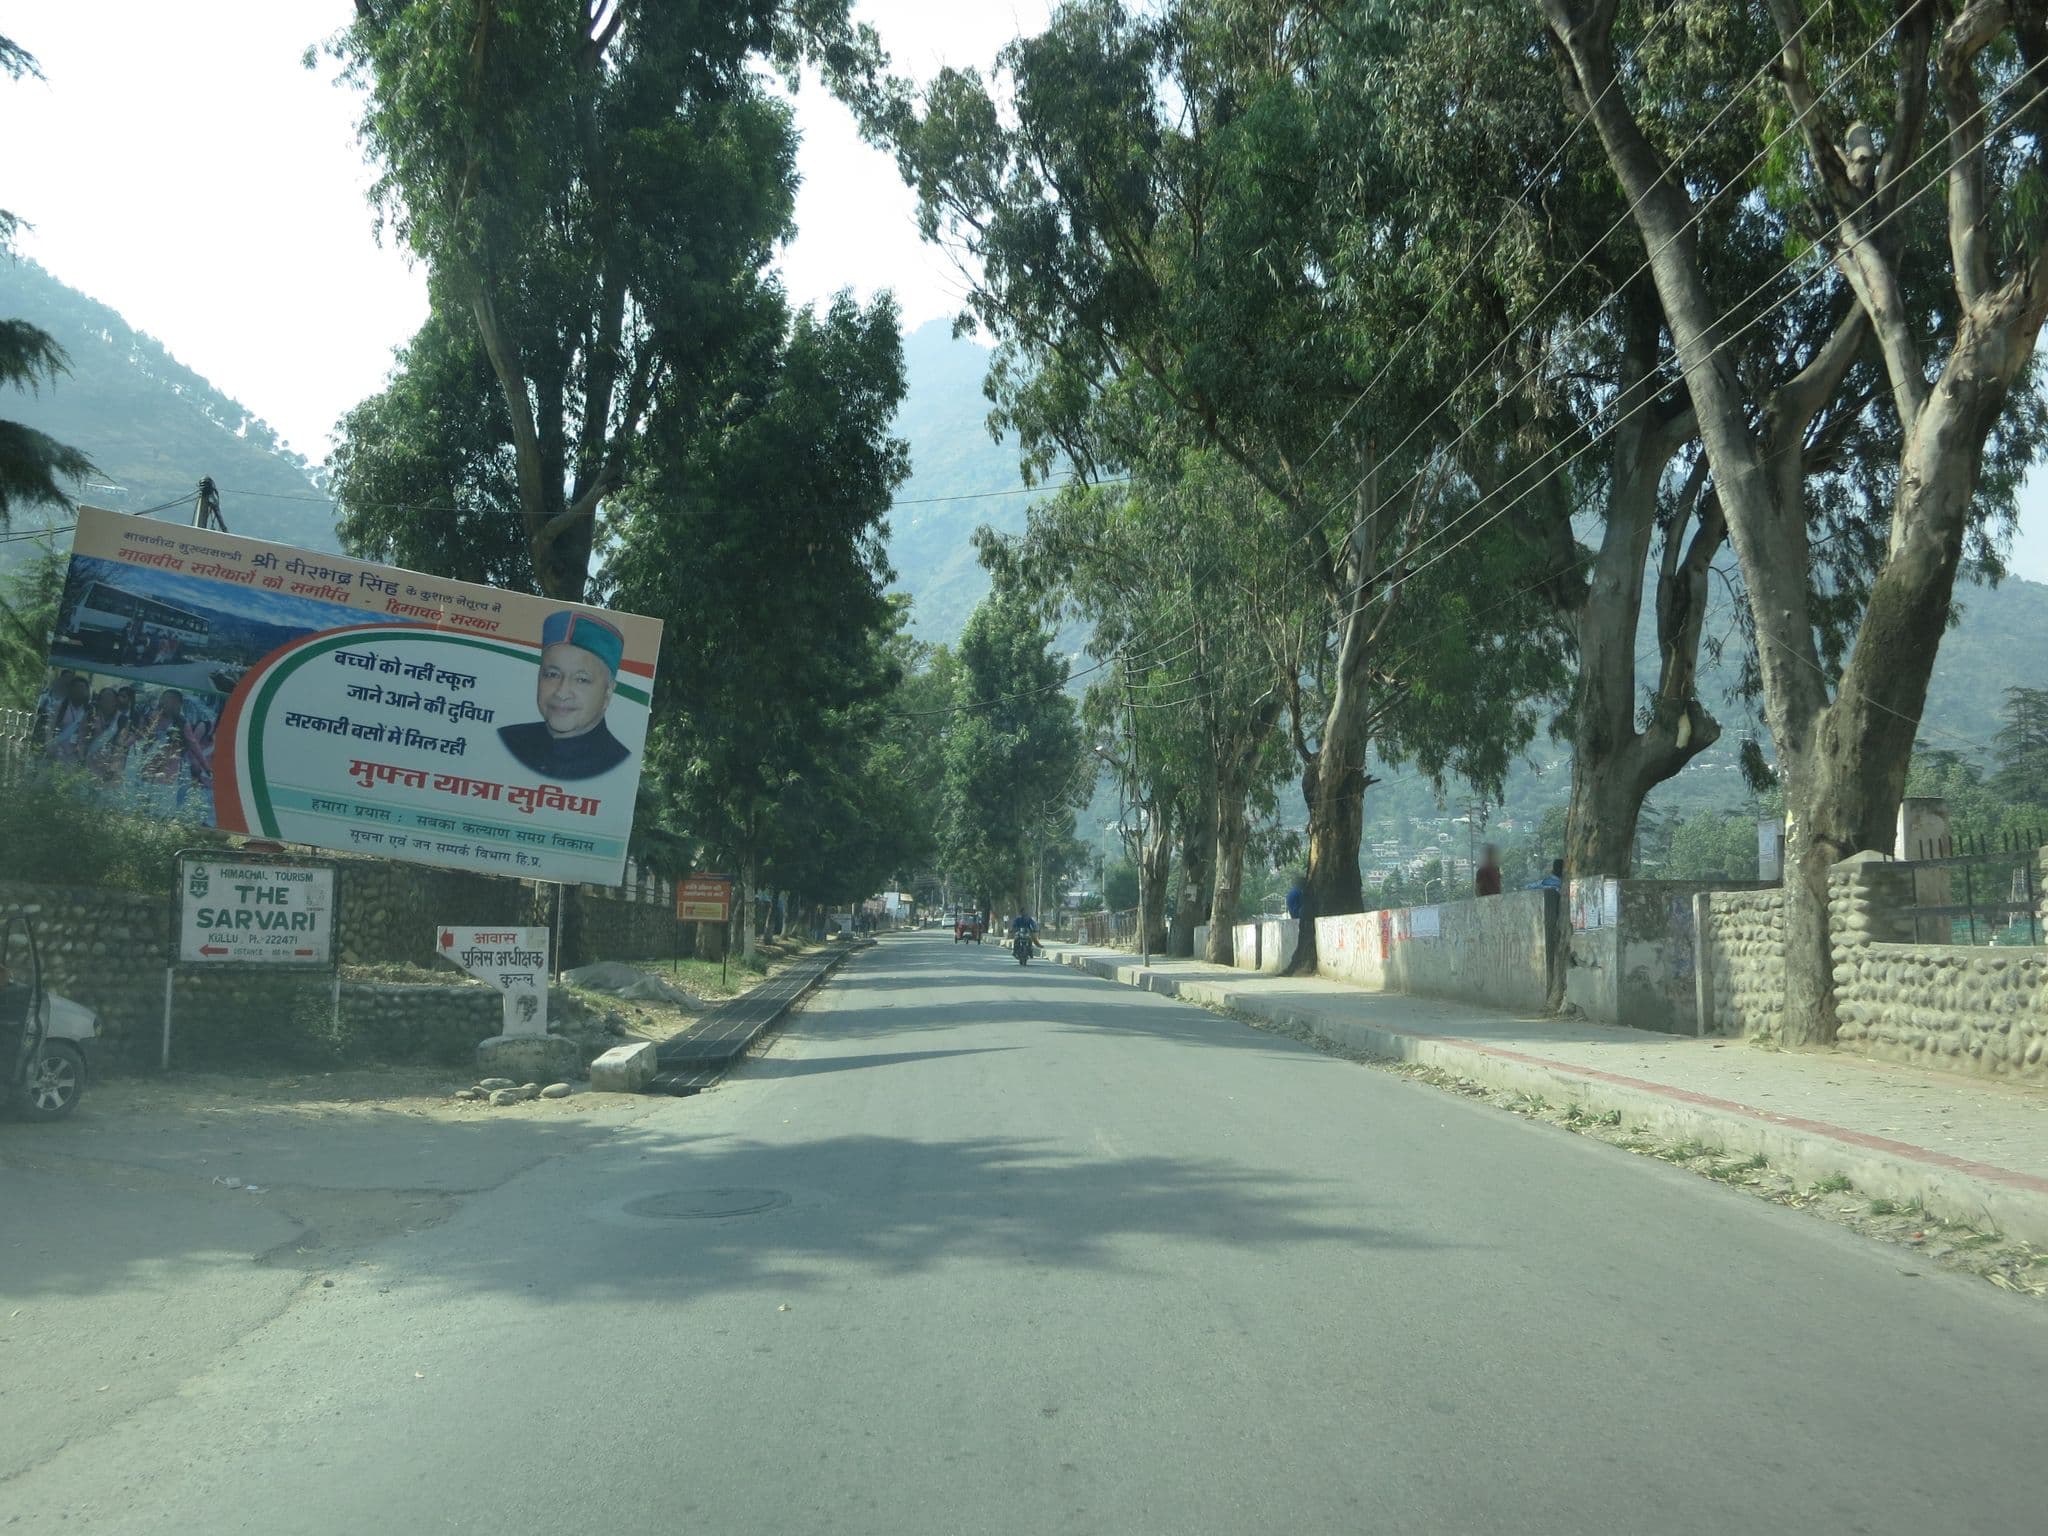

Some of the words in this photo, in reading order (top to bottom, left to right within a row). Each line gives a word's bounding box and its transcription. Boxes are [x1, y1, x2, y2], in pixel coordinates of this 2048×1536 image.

[117, 548, 184, 571] मानवीय
[191, 561, 257, 584] सरोकारों
[262, 575, 284, 590] को
[290, 581, 351, 603] समर्पित
[385, 597, 445, 621] हिमाचल
[450, 612, 501, 632] सरकार
[251, 552, 280, 570] श्री
[285, 558, 353, 586] वीरभद्र
[358, 571, 400, 596] सिंह
[406, 585, 417, 597] के
[334, 650, 379, 671] बच्चों
[379, 656, 401, 676] को
[404, 662, 437, 682] नहीं
[435, 669, 477, 691] स्कूल
[347, 684, 384, 704] जाने
[385, 690, 422, 711] आने
[423, 695, 448, 715] की
[447, 701, 495, 724] दुविधा
[285, 711, 349, 736] सरकारी
[351, 722, 388, 742] बसों
[387, 726, 406, 745] में
[404, 729, 439, 751] मिल
[439, 737, 467, 756] रही
[349, 759, 429, 789] मुफ्त
[434, 773, 504, 801] यात्रा
[508, 784, 601, 817] सुविधा
[312, 797, 348, 813] हमारा
[355, 804, 392, 821] प्रयास
[416, 816, 456, 831] सबका
[462, 822, 510, 840] कल्याण
[516, 831, 547, 845] समग्र
[551, 833, 595, 852] विकास
[350, 829, 383, 845] सूचना
[389, 834, 407, 849] एवं
[412, 838, 431, 850] जन
[475, 845, 511, 863] विभाग
[220, 868, 268, 881] HIMACHAL
[275, 871, 314, 883] TOURISM
[234, 884, 290, 905] THE
[196, 907, 316, 932] SARVARI
[208, 933, 239, 944] KULLU
[474, 933, 517, 945] आवास
[461, 946, 495, 969] पुलिस
[494, 946, 544, 969] अधीक्षक
